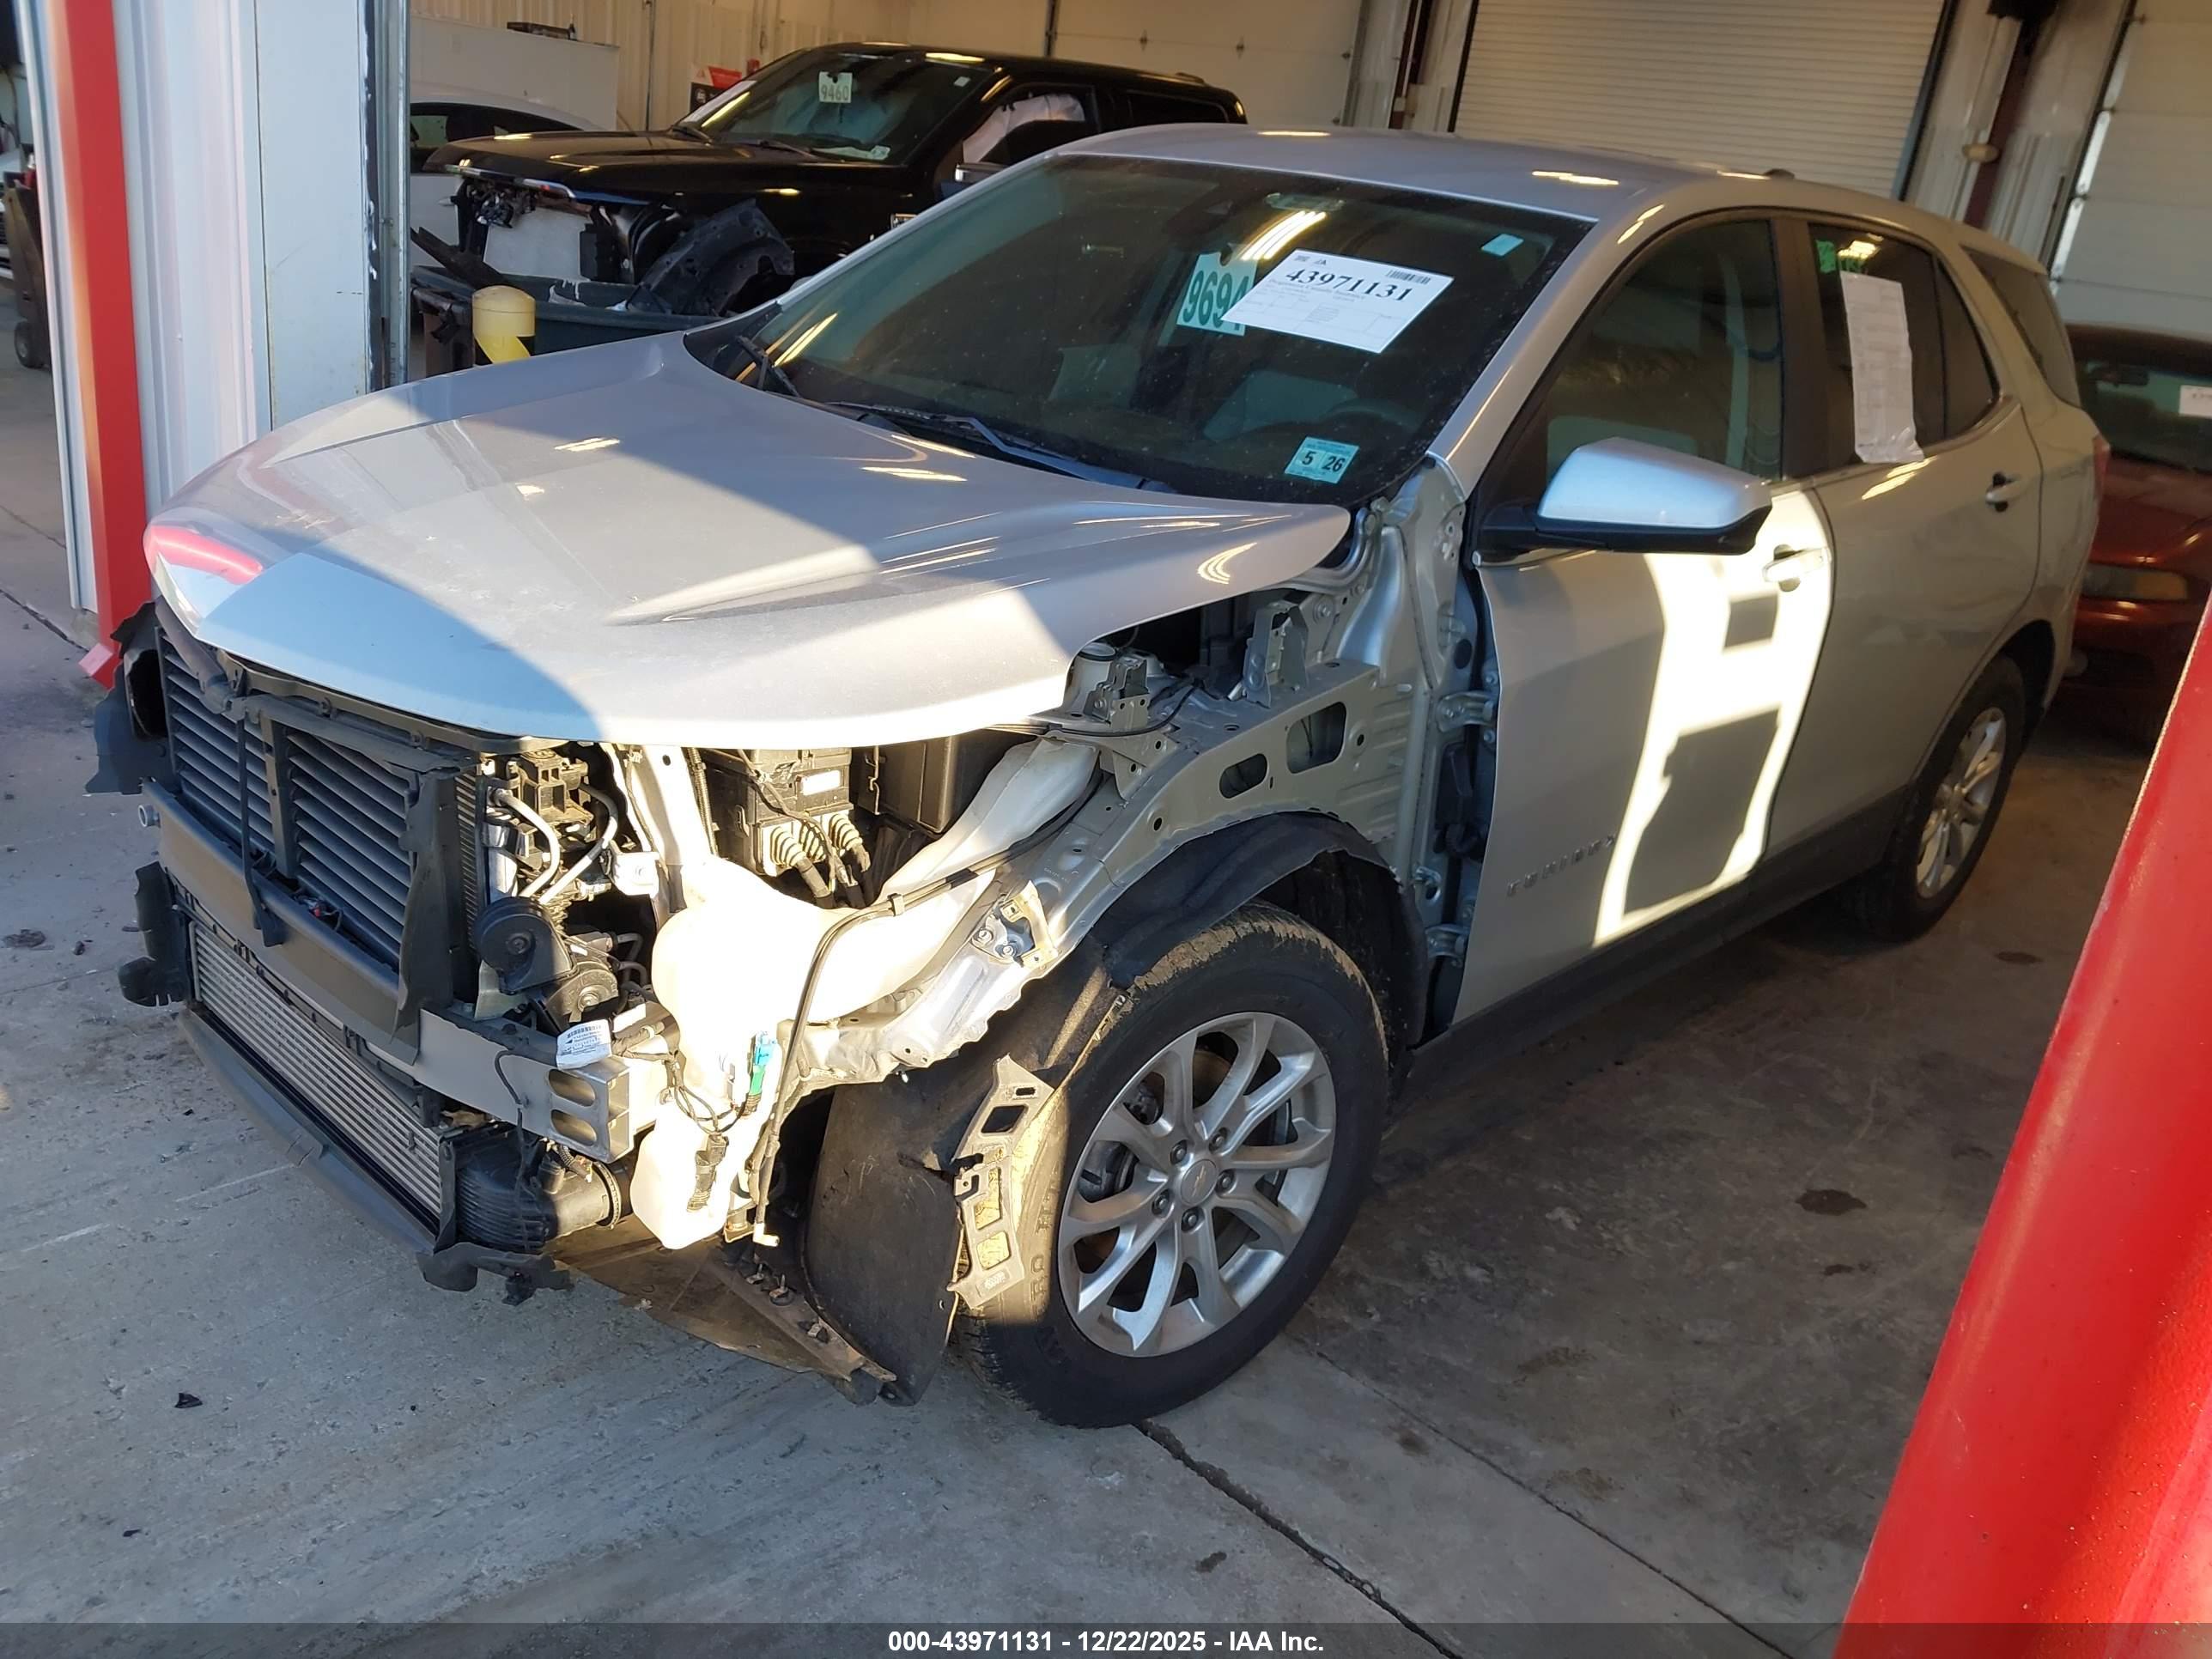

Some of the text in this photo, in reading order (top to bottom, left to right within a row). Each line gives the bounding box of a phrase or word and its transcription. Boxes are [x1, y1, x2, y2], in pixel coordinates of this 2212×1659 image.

[821, 85, 849, 100] 9460
[1286, 269, 1413, 301] 43971131
[1302, 451, 1346, 472] 5 26
